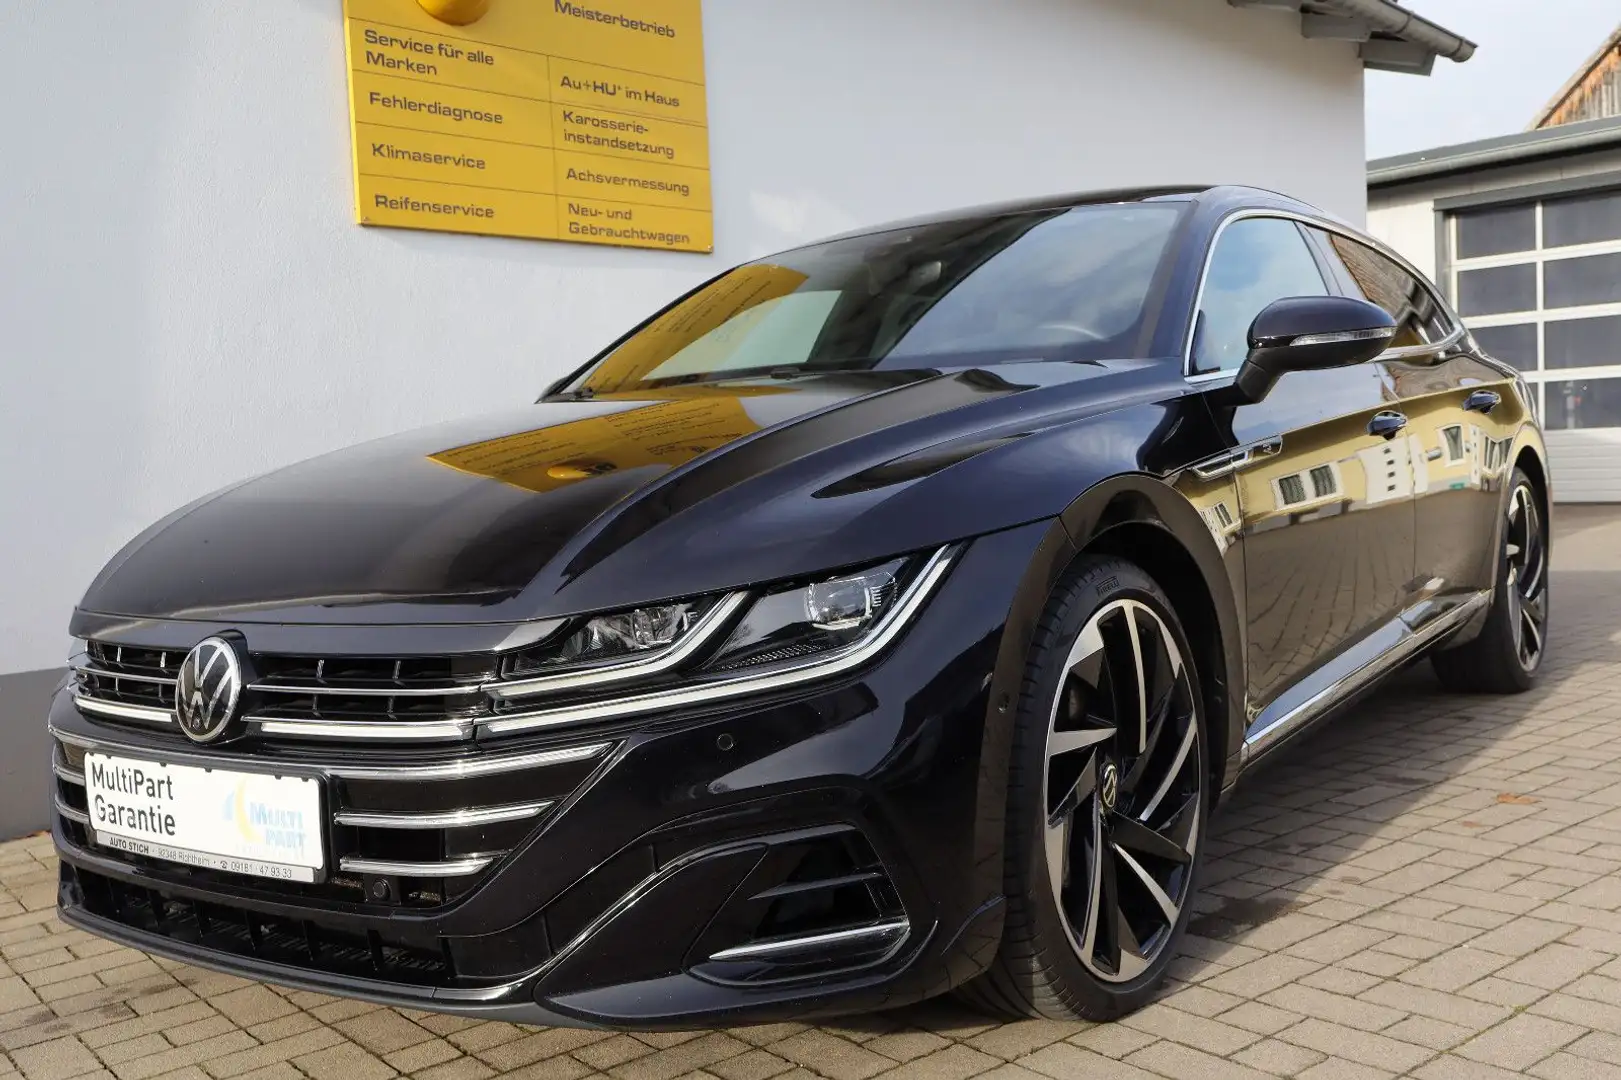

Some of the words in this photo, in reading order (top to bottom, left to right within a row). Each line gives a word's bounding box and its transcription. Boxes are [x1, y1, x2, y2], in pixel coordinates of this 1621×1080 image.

[554, 0, 675, 38] Meisterbetrieb
[364, 29, 434, 56] Service
[437, 43, 464, 60] für
[467, 48, 494, 66] alle
[366, 51, 437, 76] Marken
[369, 92, 503, 125] Fehlerdiagnose
[625, 86, 642, 101] im
[644, 89, 680, 107] Haus
[563, 110, 648, 135] Karosserie-
[371, 143, 486, 170] Klimaservice
[564, 129, 674, 159] instandsetzung
[566, 168, 690, 197] Achsvermessung
[374, 194, 494, 219] Reifenservice
[568, 203, 603, 218] Neu-
[606, 206, 633, 221] und
[568, 221, 690, 245] Gebrauchtwagen
[91, 761, 174, 801] MultiPart
[94, 795, 176, 836] Garantie
[109, 837, 127, 849] AUTO
[128, 842, 149, 854] STICH
